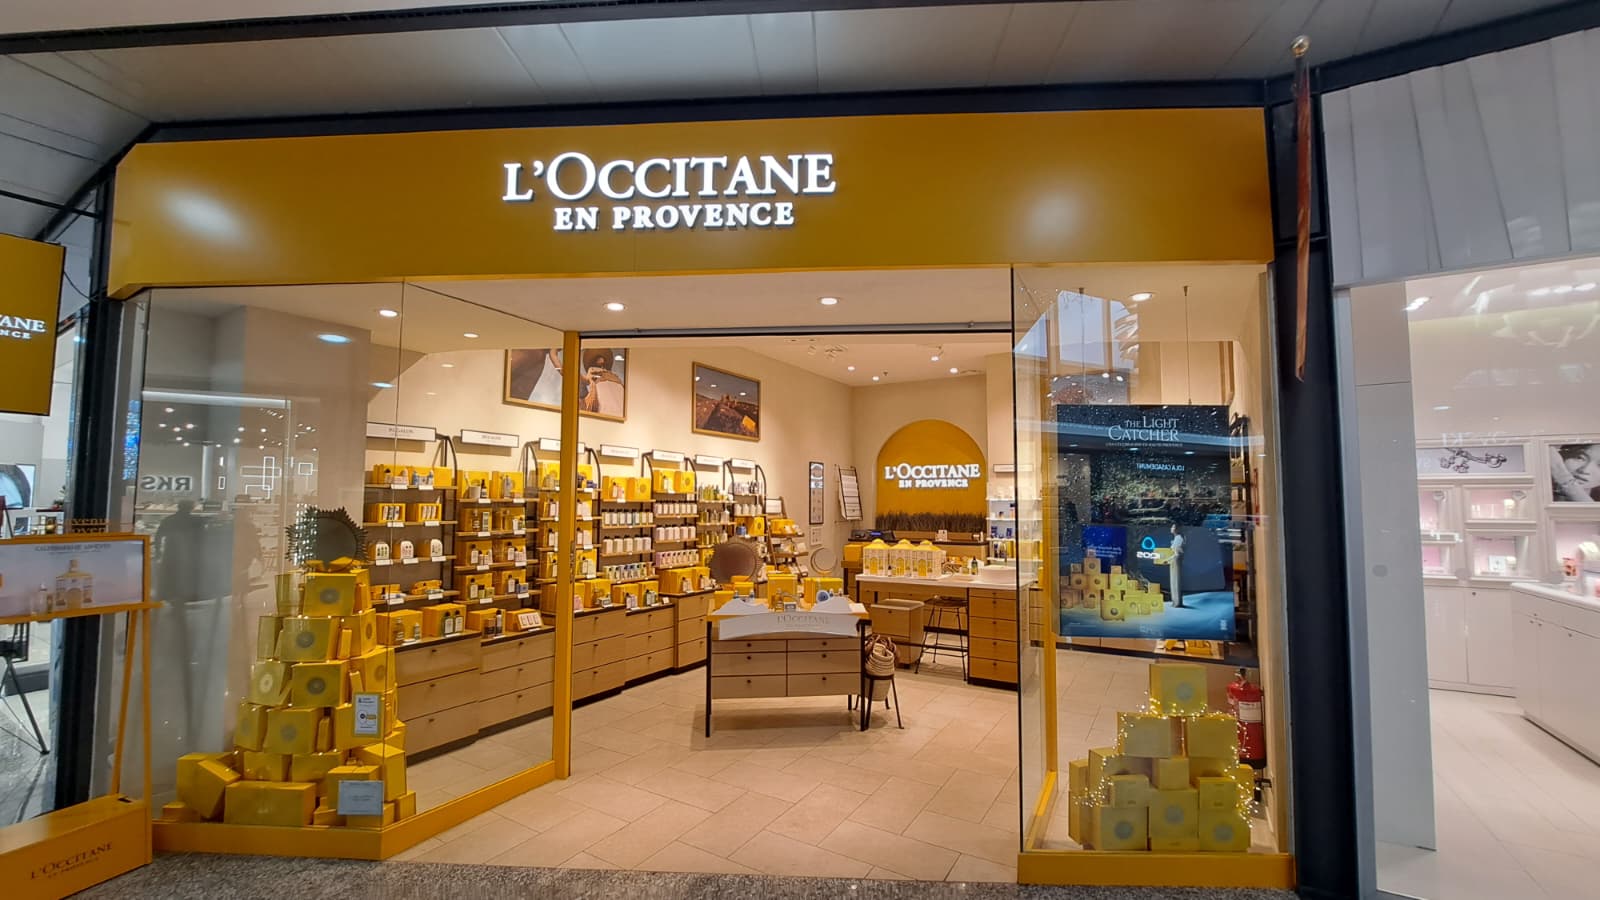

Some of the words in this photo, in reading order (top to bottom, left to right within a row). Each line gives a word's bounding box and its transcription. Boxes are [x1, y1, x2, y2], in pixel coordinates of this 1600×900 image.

[553, 206, 600, 230] EN
[611, 202, 795, 230] PROVENCE
[0, 315, 46, 332] ANE
[1124, 419, 1141, 429] THE
[1143, 416, 1180, 429] LIGHT
[1108, 425, 1180, 441] CATCHER
[898, 479, 912, 488] EN
[915, 479, 968, 488] PROVENCE
